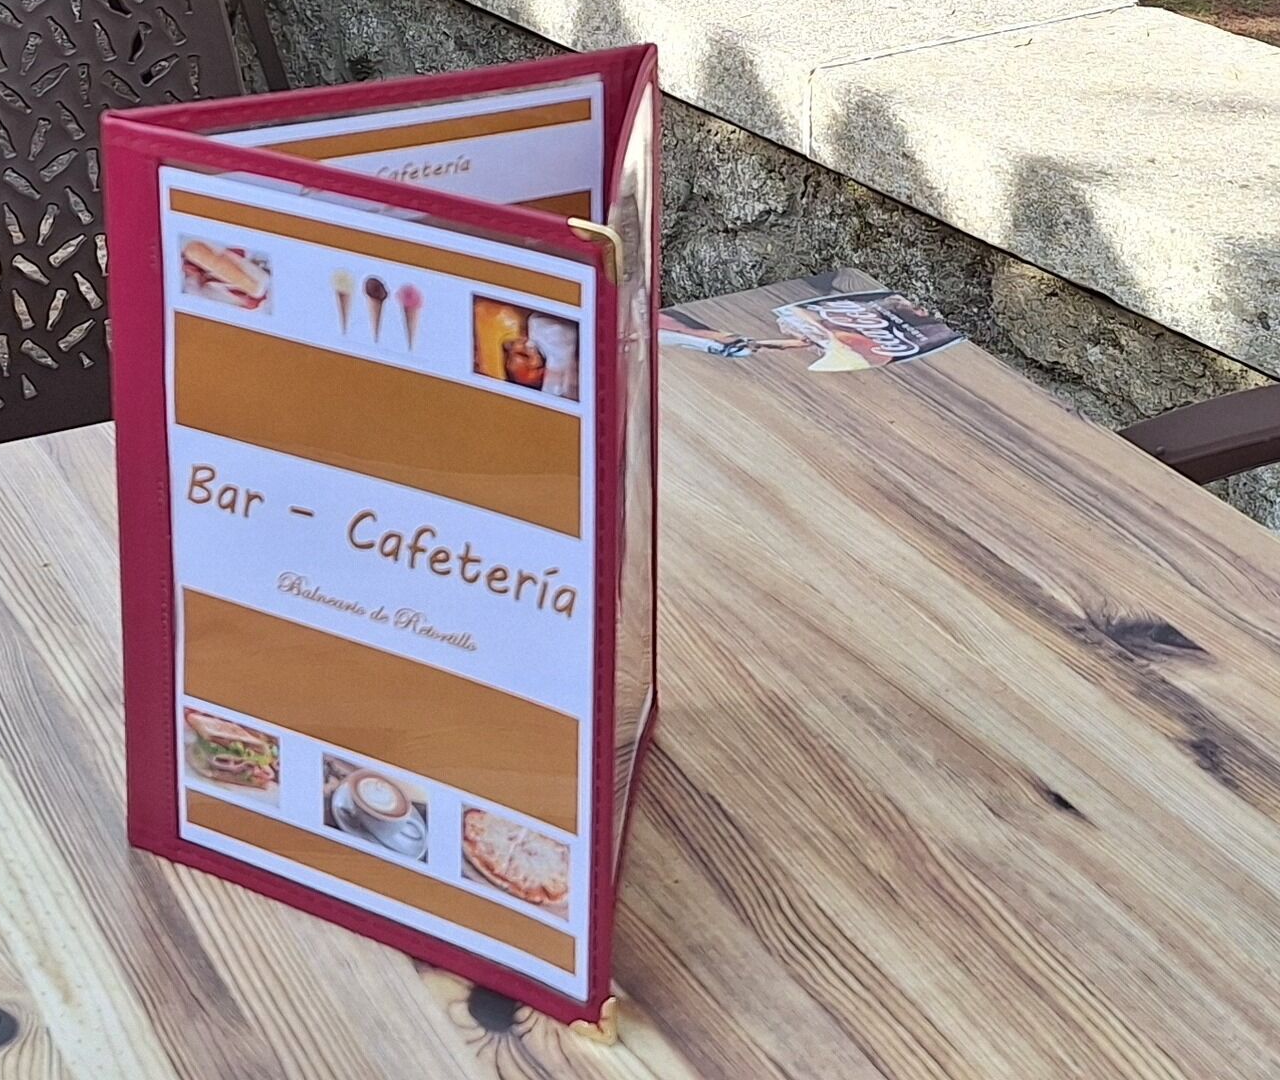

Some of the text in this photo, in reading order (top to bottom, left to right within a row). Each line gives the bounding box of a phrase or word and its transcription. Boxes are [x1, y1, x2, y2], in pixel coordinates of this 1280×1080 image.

[186, 464, 265, 518] Bar
[346, 509, 579, 618] Cafetería
[277, 571, 478, 653] Balneario de Retortillo
